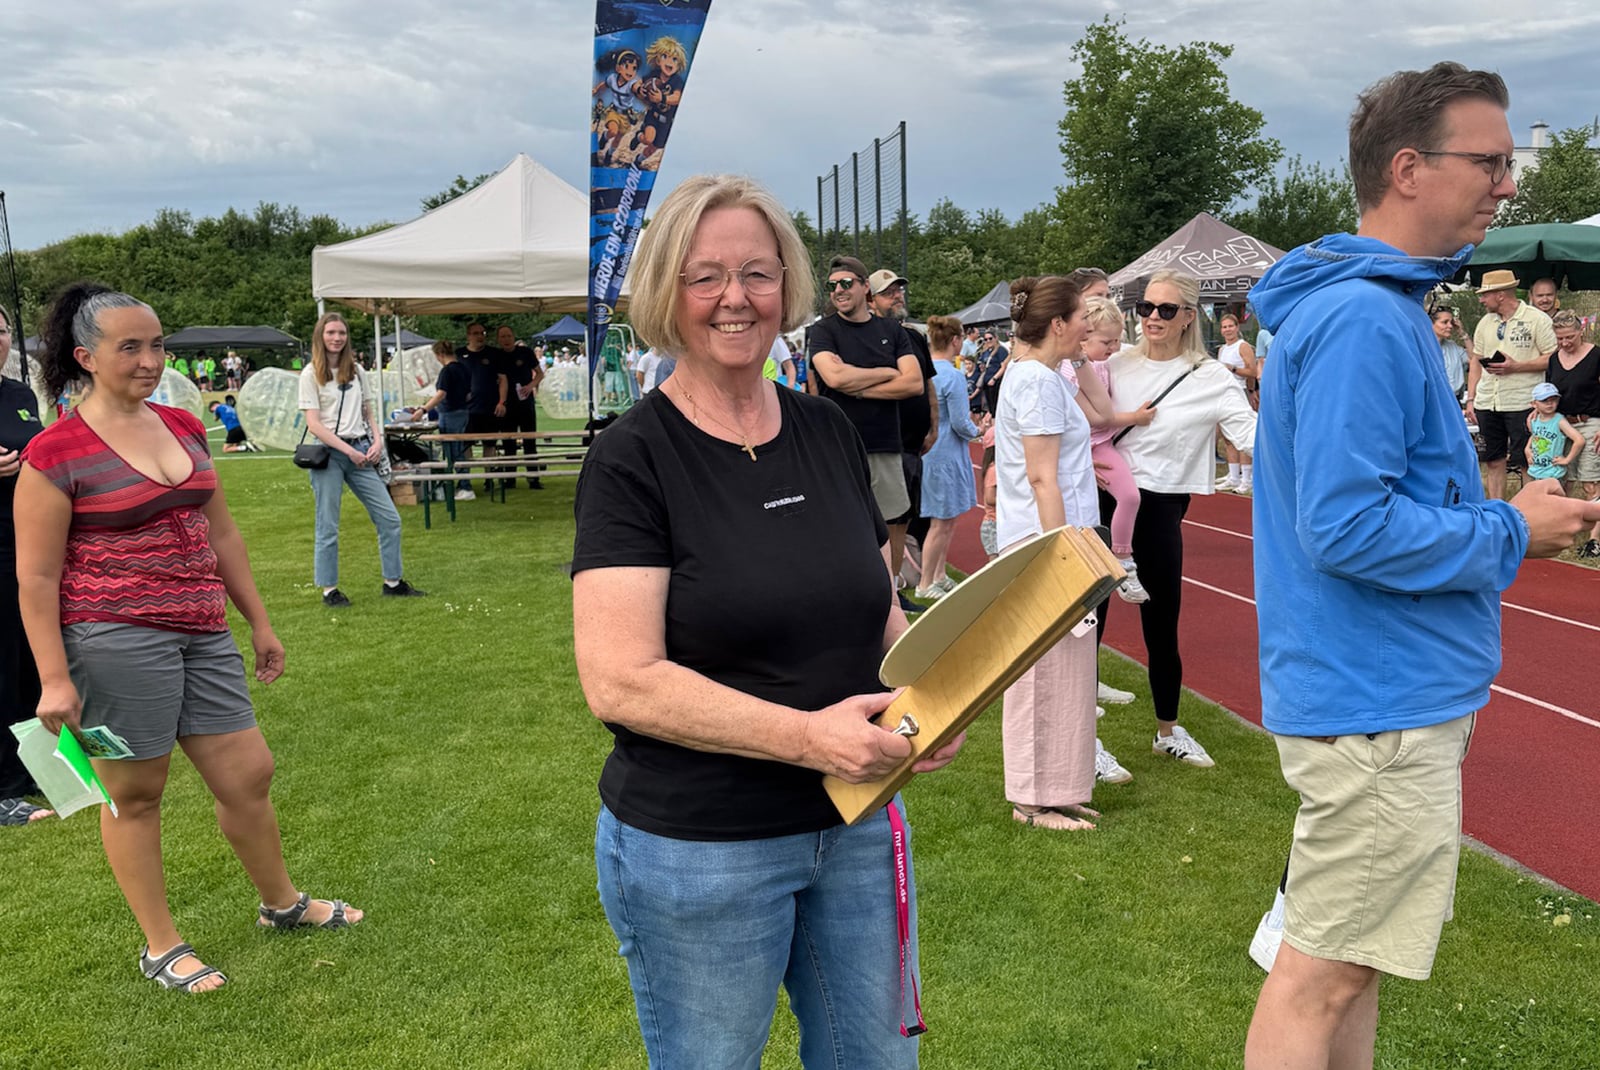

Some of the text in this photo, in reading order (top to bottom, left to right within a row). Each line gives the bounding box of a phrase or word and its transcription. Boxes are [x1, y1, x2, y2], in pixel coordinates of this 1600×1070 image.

[613, 162, 642, 234] SCORPION!
[606, 232, 622, 258] EIN
[1186, 239, 1254, 265] MAIN
[1198, 251, 1259, 272] SUP
[594, 255, 616, 300] WERDE
[894, 831, 906, 903] mr-lunch.de
